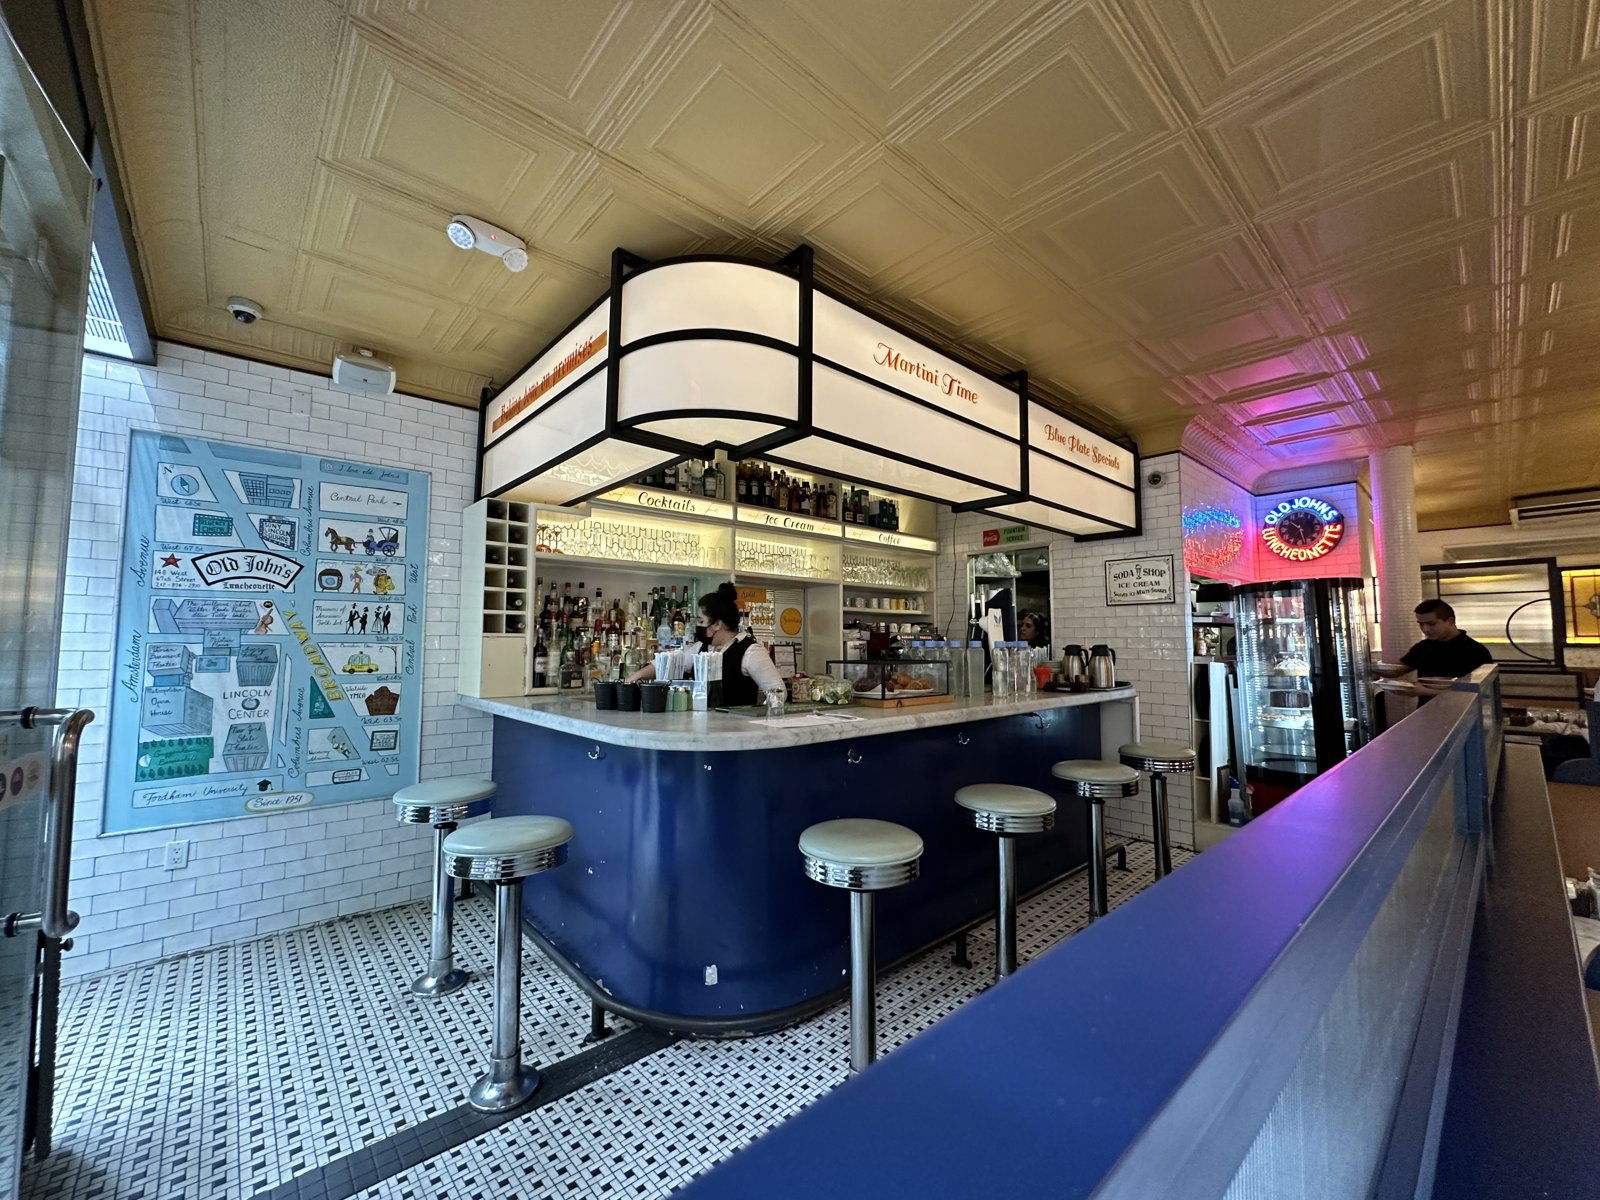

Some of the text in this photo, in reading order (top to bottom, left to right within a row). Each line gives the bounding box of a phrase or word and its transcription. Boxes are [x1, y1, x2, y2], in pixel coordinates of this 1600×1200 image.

[553, 336, 593, 387] premises
[873, 342, 978, 404] Martini Time
[1044, 424, 1120, 470] Blue Plate Specials
[330, 492, 388, 505] Central Park
[638, 492, 696, 512] Cocktails
[1265, 502, 1291, 525] OLD
[265, 528, 291, 537] LINCOLN
[783, 517, 815, 532] Cream
[1003, 525, 1026, 535] FOUNTAIN
[878, 533, 901, 545] Coffee
[1261, 524, 1342, 561] LUNCHEONETTE
[206, 556, 239, 576] Old
[244, 555, 294, 579] John's
[409, 563, 419, 584] West
[1113, 567, 1166, 581] SODA SHOP
[223, 582, 275, 591] Luncheonette
[1133, 580, 1161, 588] CREAM
[121, 534, 150, 703] Amsterdam Avenue
[283, 609, 344, 702] BROADWAY
[405, 639, 417, 676] Central
[223, 689, 272, 699] LINCOLN
[150, 709, 173, 717] House
[228, 708, 270, 720] CENTER
[287, 687, 305, 778] Columbus Avenue
[142, 783, 248, 806] Fordham University
[253, 794, 303, 807] Since 1951
